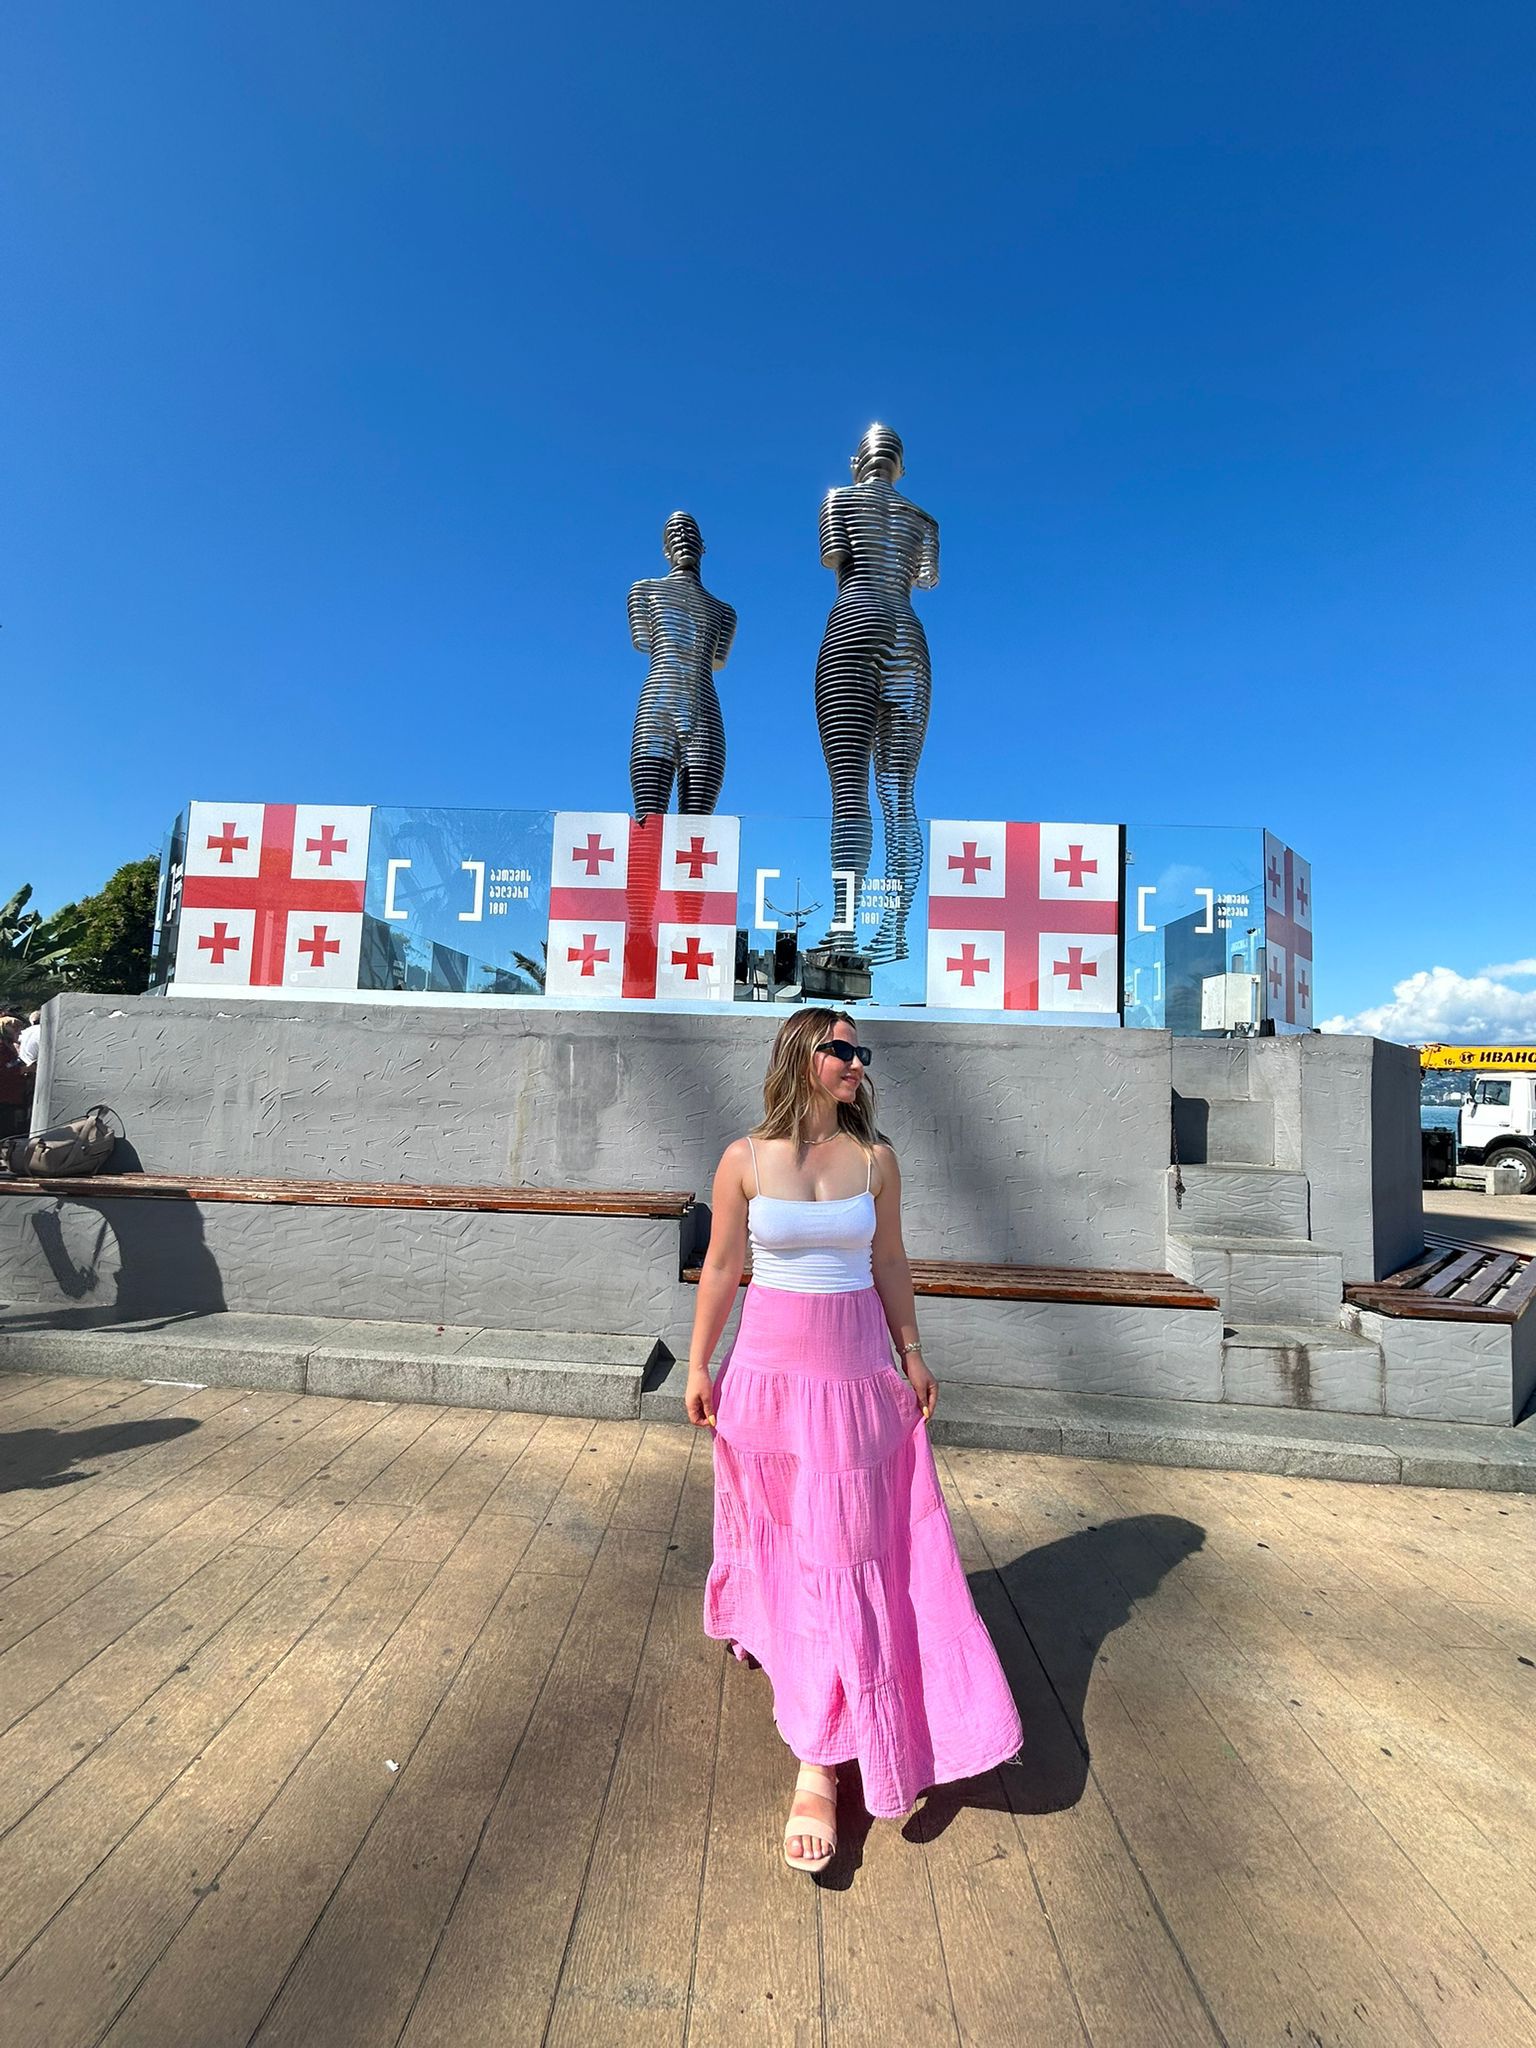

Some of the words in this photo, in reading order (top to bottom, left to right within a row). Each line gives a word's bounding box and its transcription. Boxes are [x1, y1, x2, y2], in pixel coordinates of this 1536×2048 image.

[490, 868, 532, 882] ბათუმის
[489, 885, 529, 899] ბულვარი
[489, 901, 508, 915] 1881
[860, 911, 880, 925] 1881
